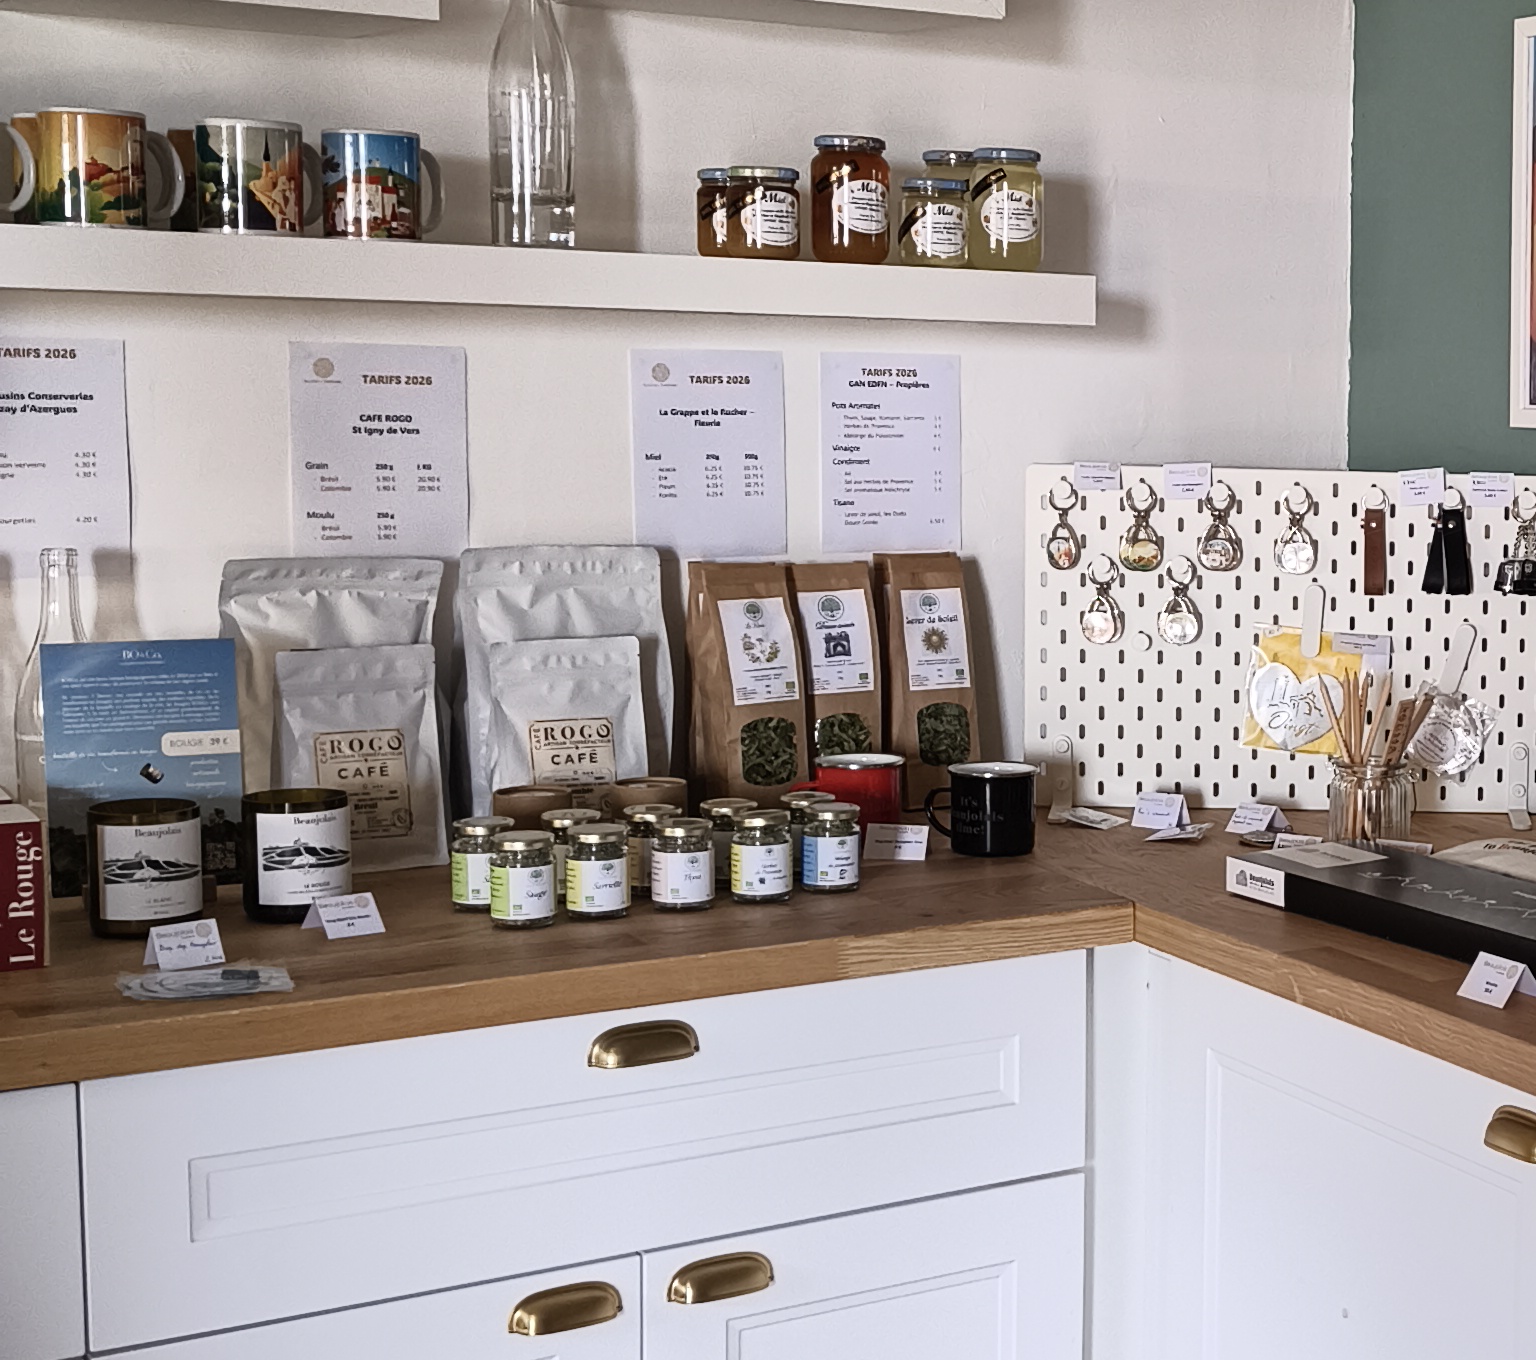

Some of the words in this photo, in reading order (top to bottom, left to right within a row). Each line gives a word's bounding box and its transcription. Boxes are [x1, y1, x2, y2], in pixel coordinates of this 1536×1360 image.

[44, 348, 77, 359] 2026
[861, 368, 893, 377] TARIFS
[895, 368, 918, 378] 2026
[362, 374, 402, 385] TARIFS
[404, 375, 433, 386] 2026
[689, 375, 724, 385] TARIFS
[726, 375, 751, 385] 2026
[0, 391, 26, 401] usins
[28, 391, 94, 401] Conserveries
[0, 405, 17, 416] zay
[352, 426, 362, 435] St
[386, 426, 398, 435] de
[399, 426, 420, 435] Vers
[305, 461, 329, 471] Grain
[1268, 710, 1322, 738] Oingt
[960, 795, 979, 807] It's
[134, 826, 182, 839] Beaujolais
[8, 830, 43, 919] Rouge
[9, 928, 36, 965] Le
